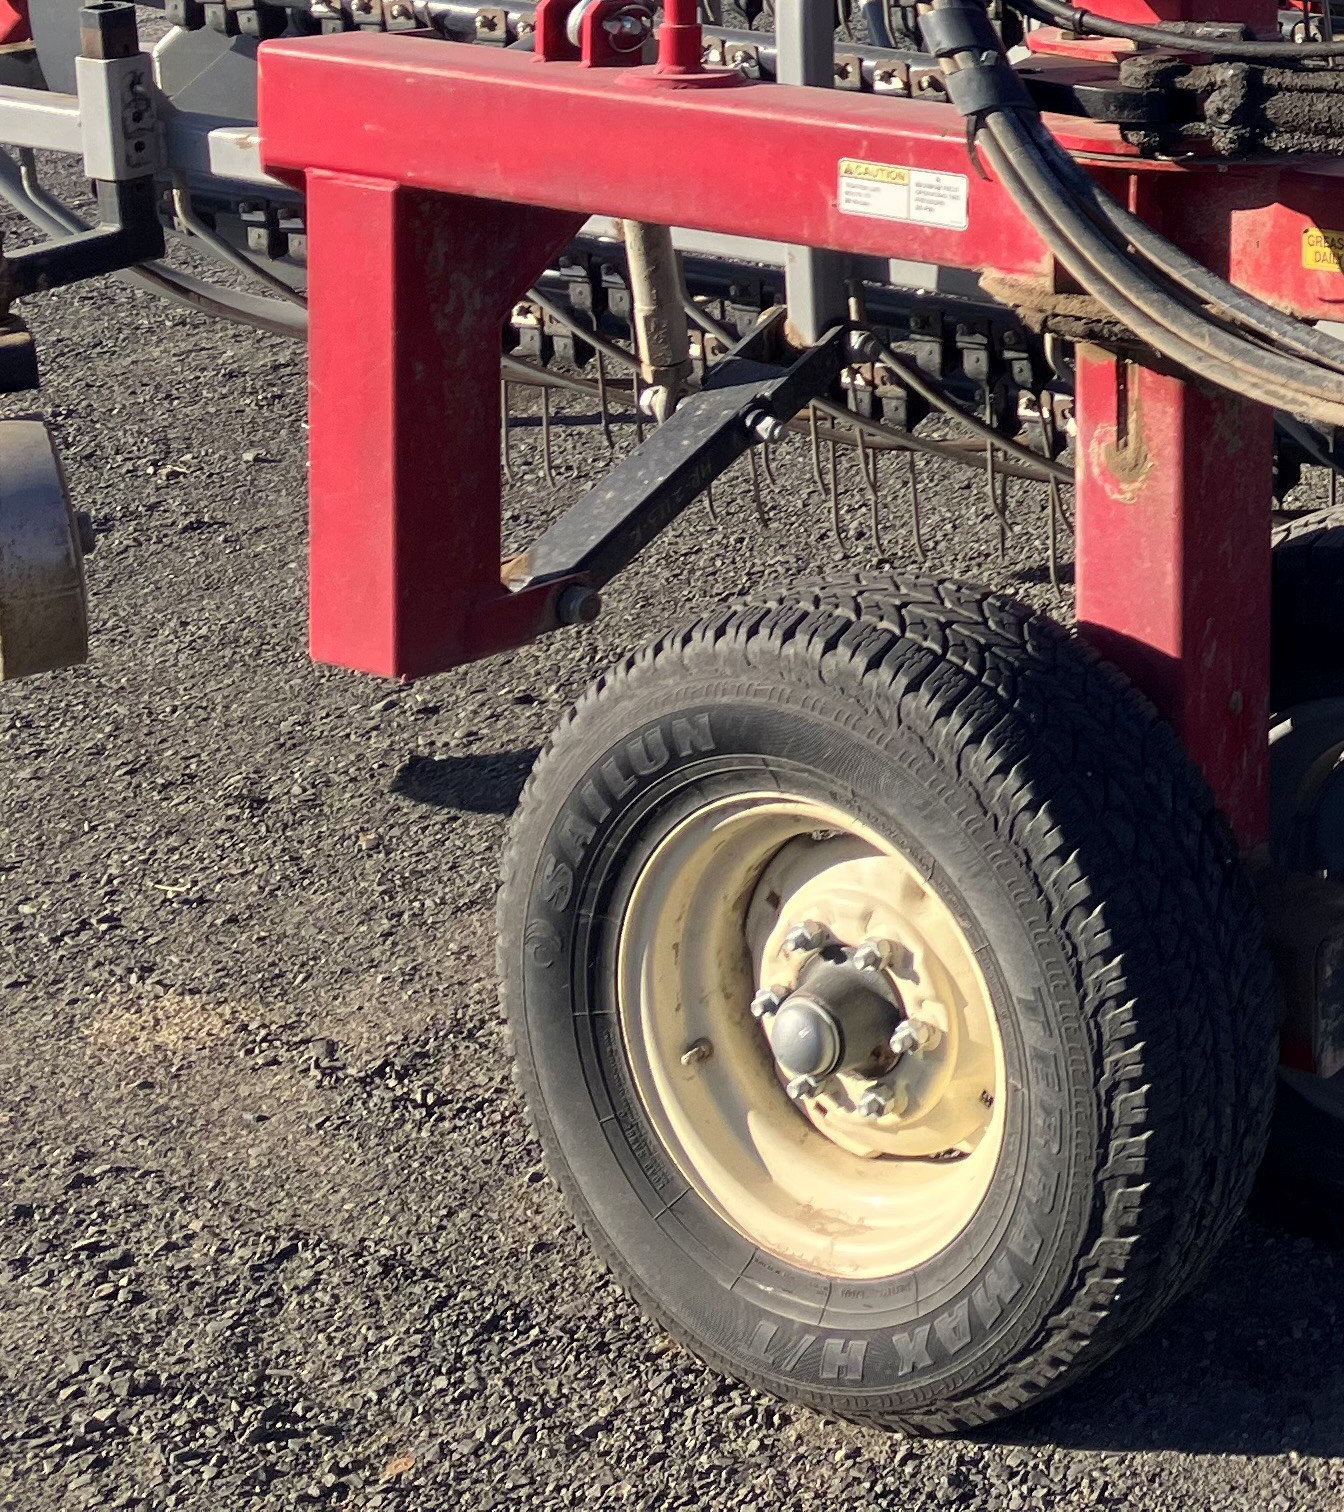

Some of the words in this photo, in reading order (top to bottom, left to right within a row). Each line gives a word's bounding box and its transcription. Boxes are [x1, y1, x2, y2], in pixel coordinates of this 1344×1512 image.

[855, 164, 906, 181] CAUTION
[1314, 251, 1344, 265] DAILY
[543, 712, 716, 912] SAILUN
[892, 986, 1061, 1377] TERRAMAX
[738, 1319, 868, 1384] H/T
